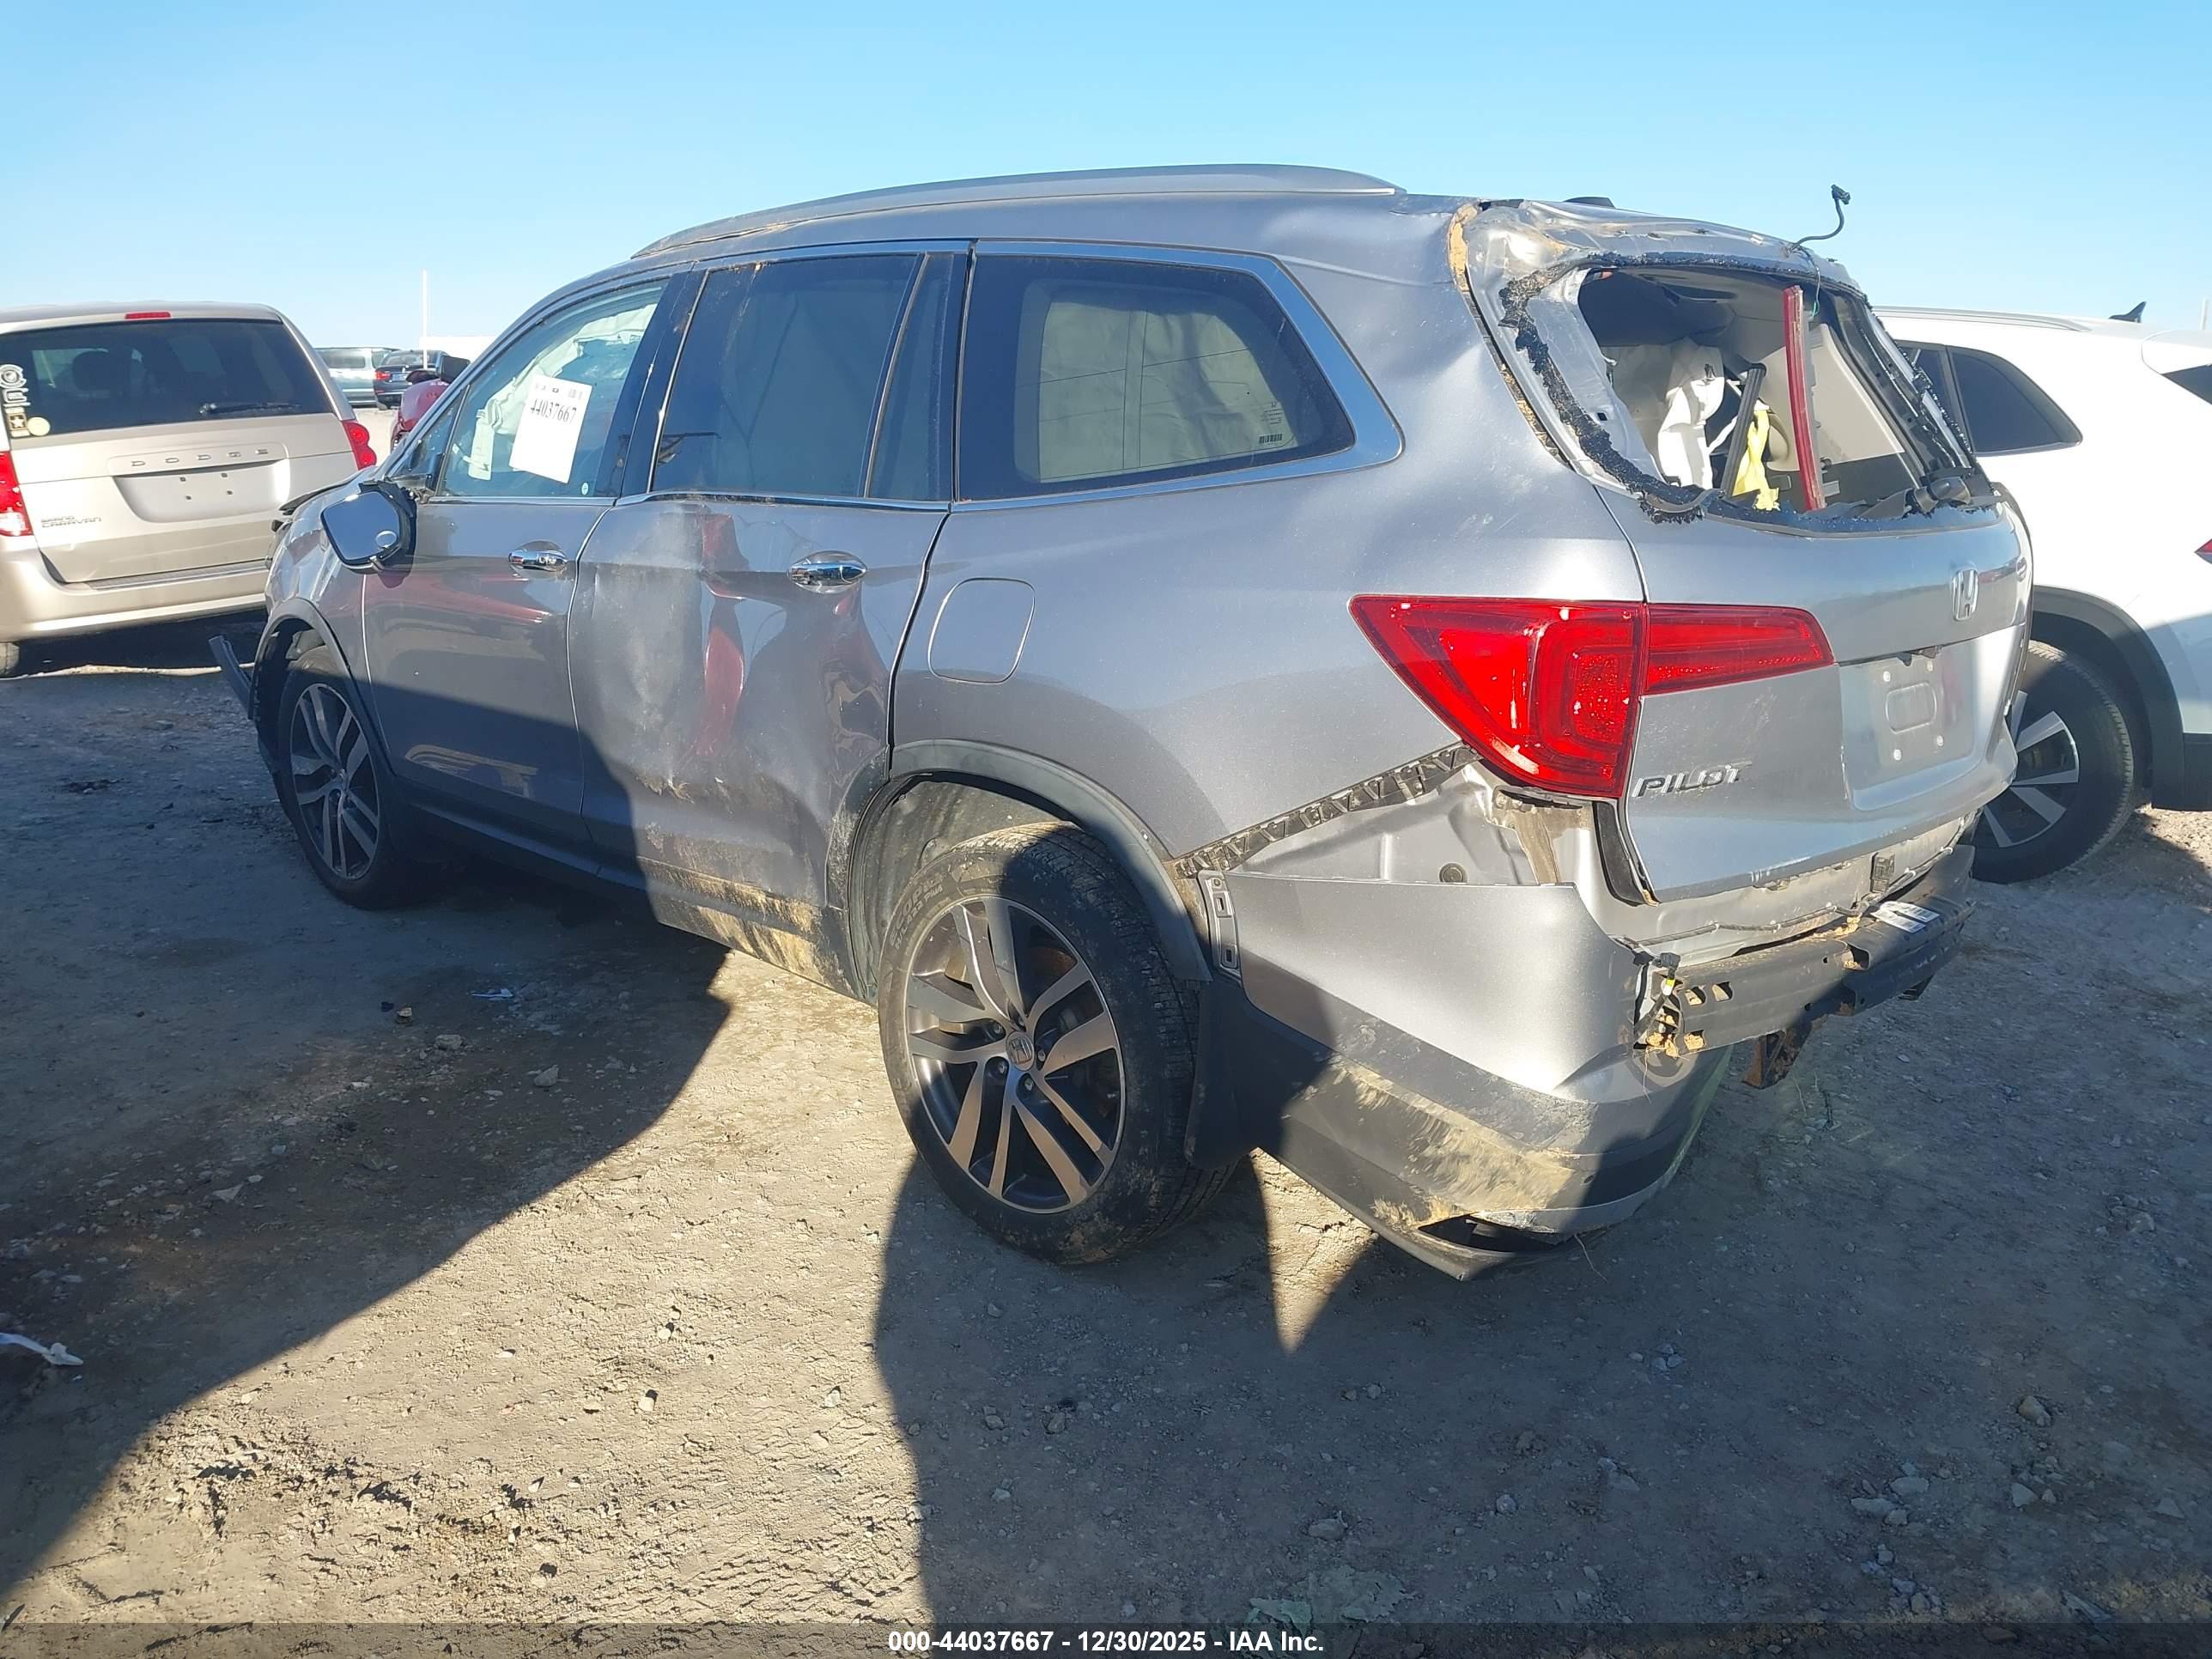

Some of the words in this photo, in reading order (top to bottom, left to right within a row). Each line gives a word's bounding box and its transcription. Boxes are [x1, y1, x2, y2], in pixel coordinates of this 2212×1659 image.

[530, 398, 577, 425] 44037667
[131, 447, 269, 467] DODGE
[1632, 761, 1752, 798] PILOT
